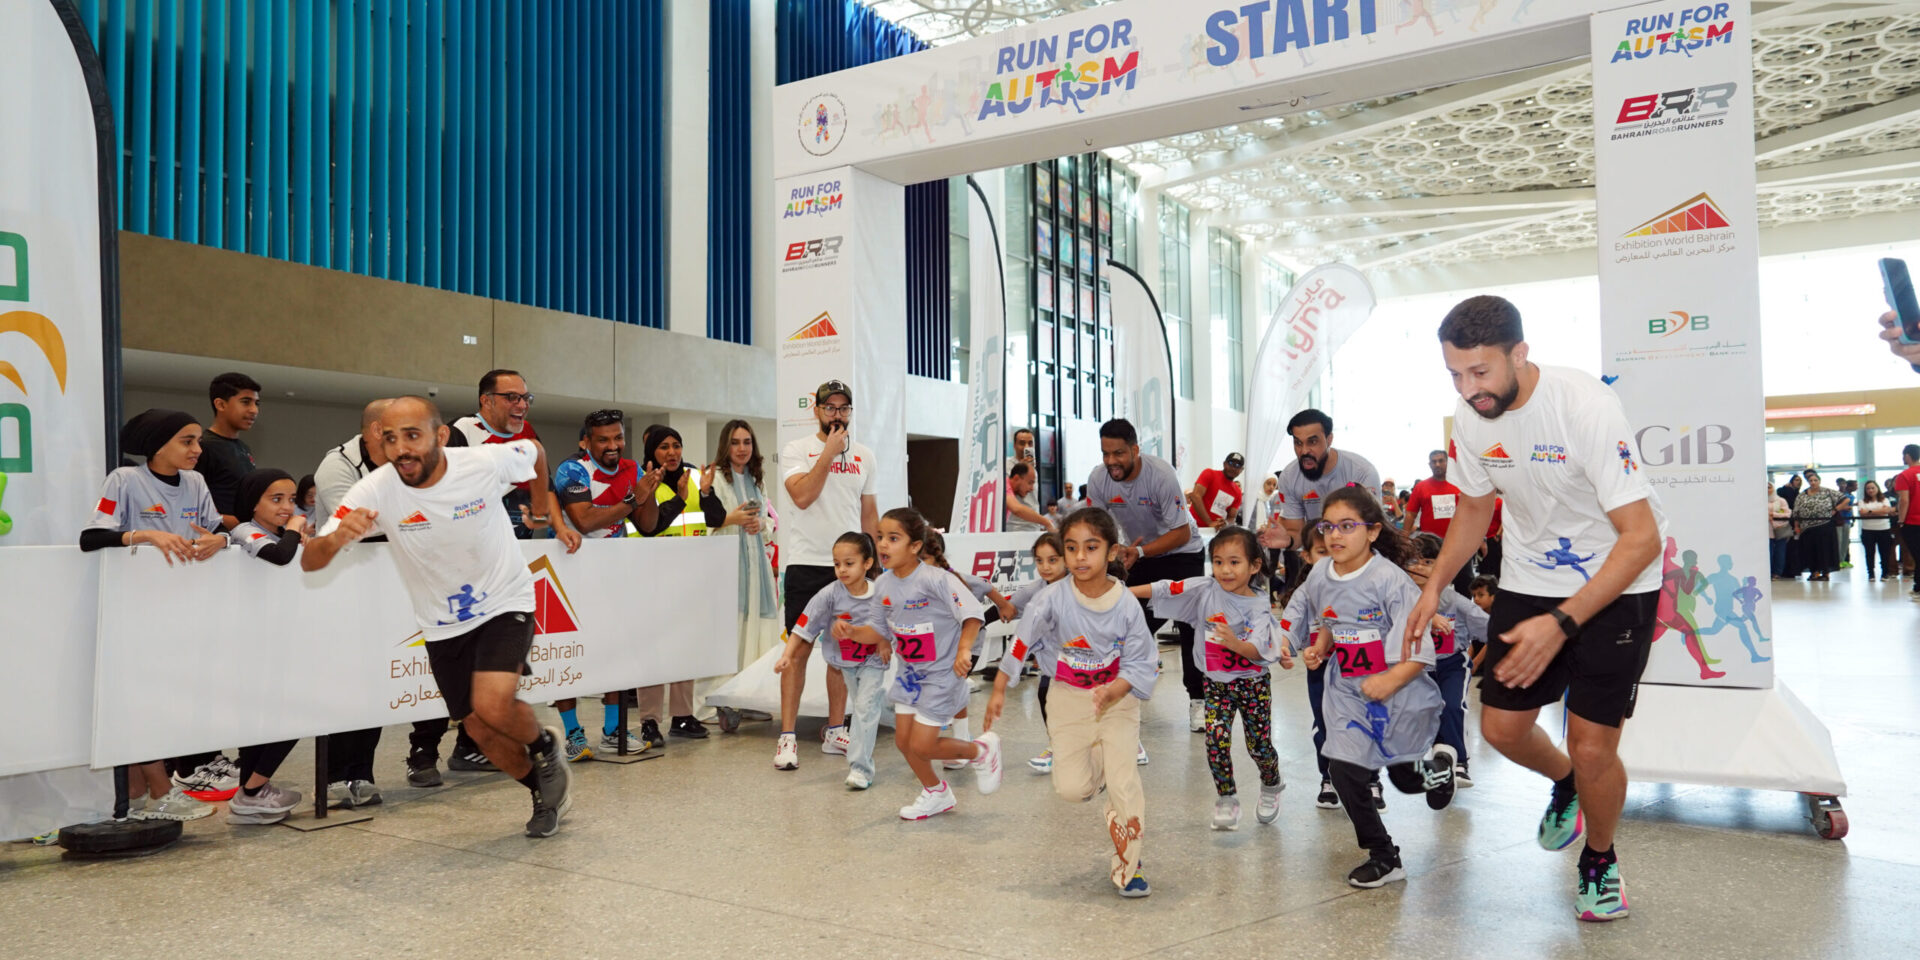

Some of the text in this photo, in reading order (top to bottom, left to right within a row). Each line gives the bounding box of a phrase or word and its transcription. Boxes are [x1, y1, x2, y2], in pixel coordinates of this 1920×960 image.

[1626, 2, 1729, 36] RUN FOR
[997, 19, 1132, 75] RUN FOR
[1610, 21, 1734, 64] AUTISM
[978, 51, 1139, 121] AUTISM
[1616, 81, 1737, 124] BRR
[791, 180, 841, 200] RUN FOR
[784, 193, 843, 218] AUTISM
[1615, 231, 1735, 251] Exhibition World Bahrain
[1616, 243, 1736, 264] مركز البحرين العالمي للمعارض
[530, 640, 584, 662] Bahrain
[1336, 647, 1373, 672] 24
[557, 666, 582, 686] مركز
